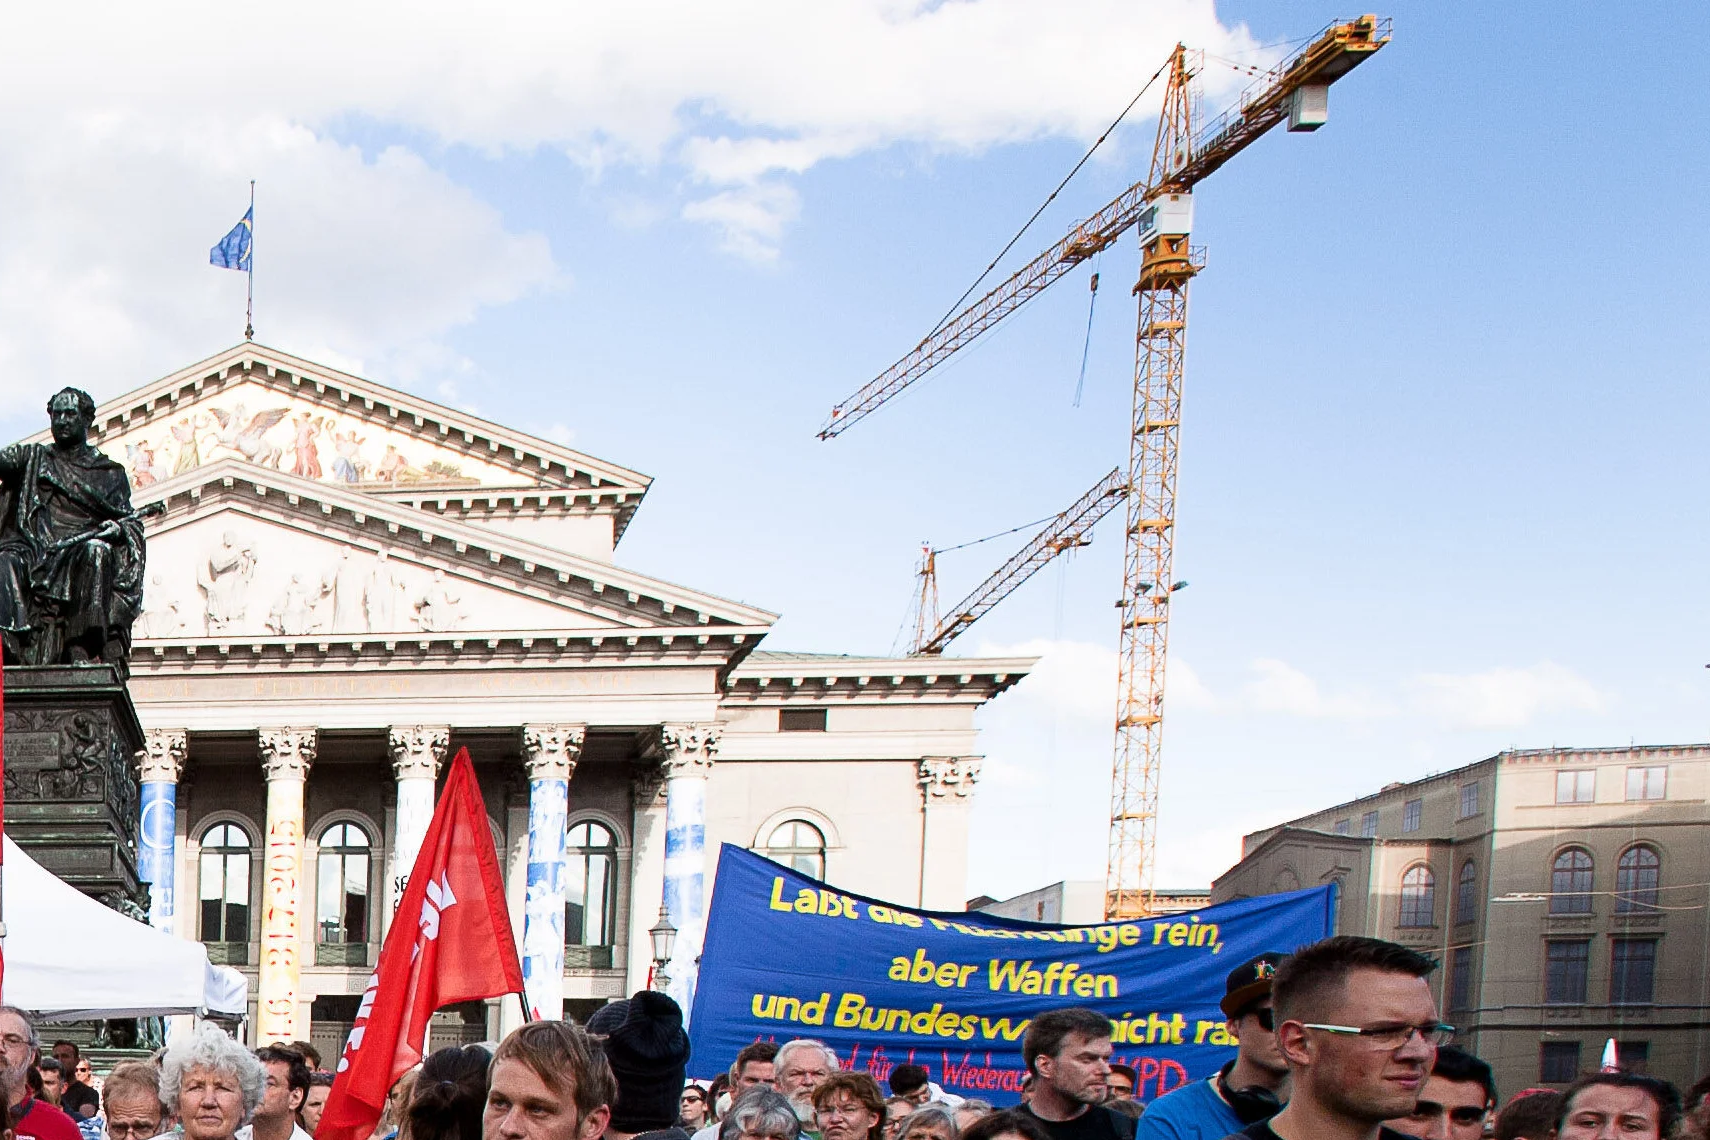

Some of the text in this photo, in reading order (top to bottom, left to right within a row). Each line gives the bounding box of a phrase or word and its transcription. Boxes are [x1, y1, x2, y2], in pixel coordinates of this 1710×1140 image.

[1152, 915, 1224, 954] rein,
[888, 949, 1118, 998] aber Waffen
[751, 993, 831, 1026] und
[834, 993, 1033, 1041] Bundesw
[1194, 1020, 1239, 1046] ra
[941, 1049, 1029, 1092] Wiederau
